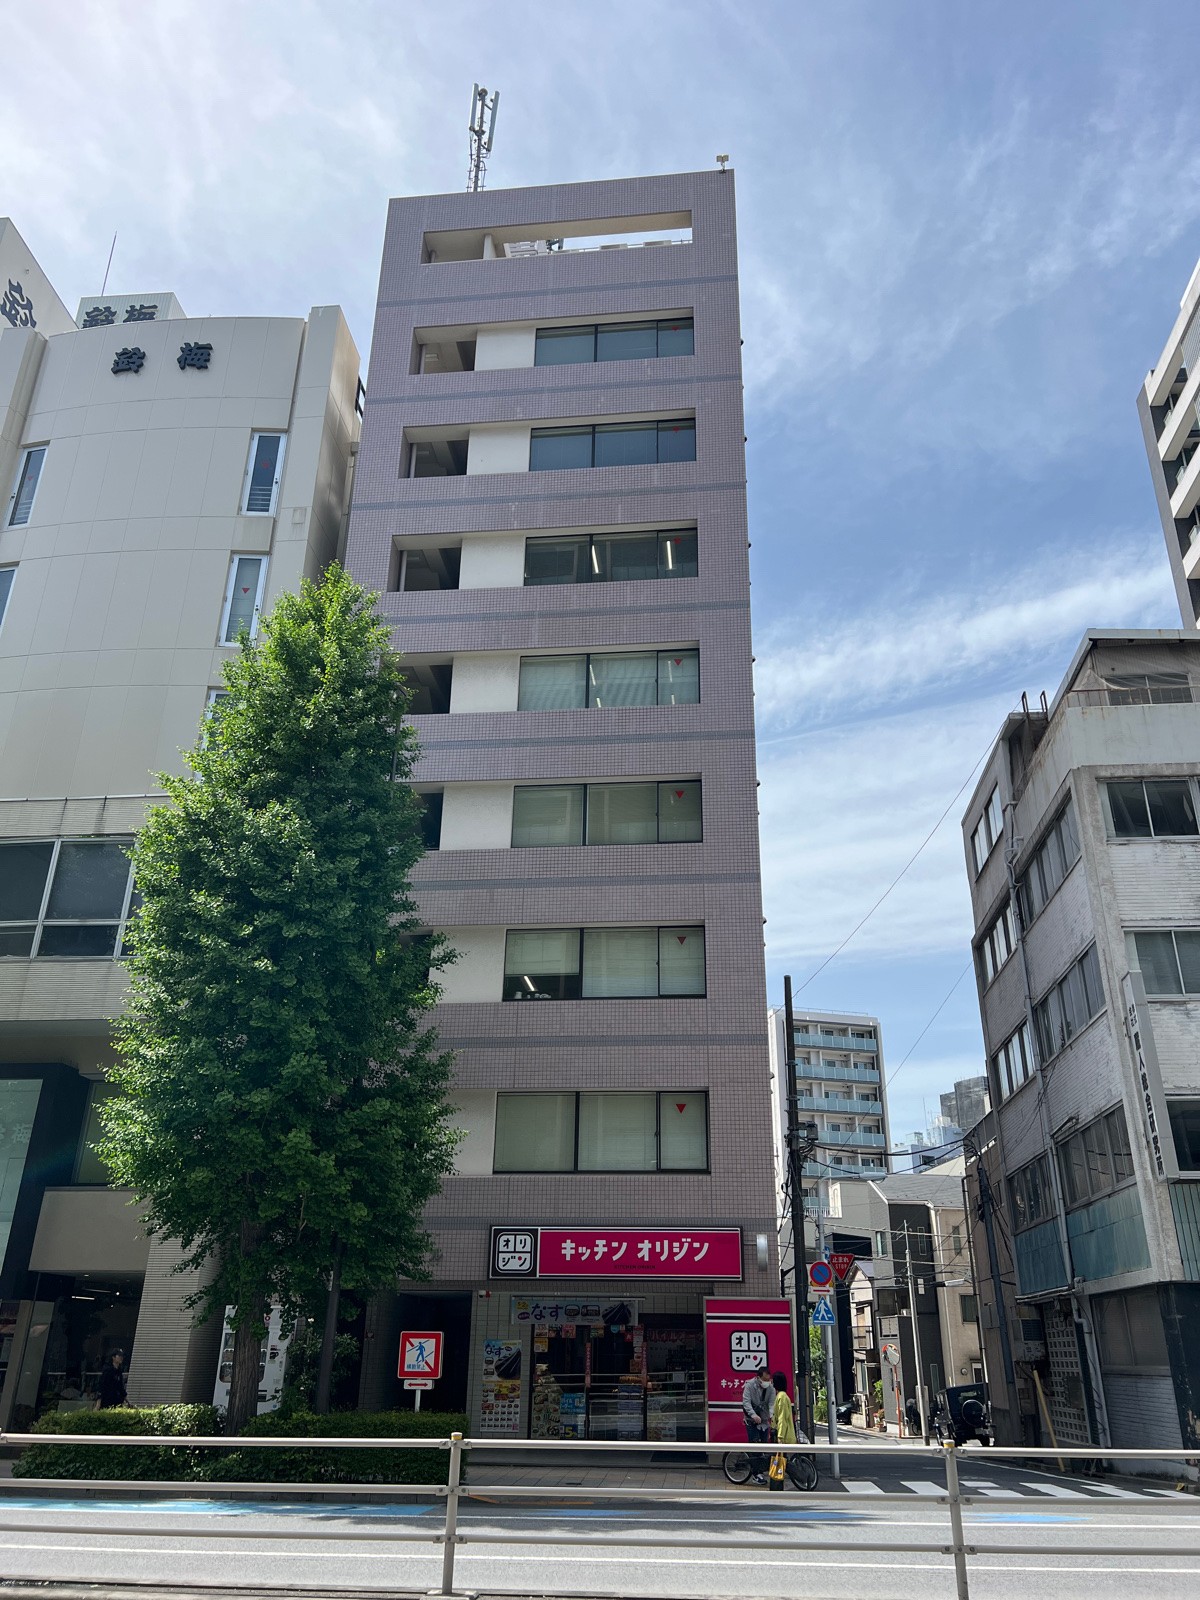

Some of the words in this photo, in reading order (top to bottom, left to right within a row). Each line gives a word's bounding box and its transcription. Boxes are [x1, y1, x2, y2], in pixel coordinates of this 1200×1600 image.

[502, 1236, 527, 1250] オリ
[561, 1239, 628, 1262] キッチン
[637, 1238, 710, 1262] オリジン
[502, 1255, 527, 1267] ジン
[531, 1303, 564, 1321] なす
[735, 1335, 761, 1348] オリ
[485, 1343, 504, 1358] なす
[735, 1355, 763, 1368] ジン
